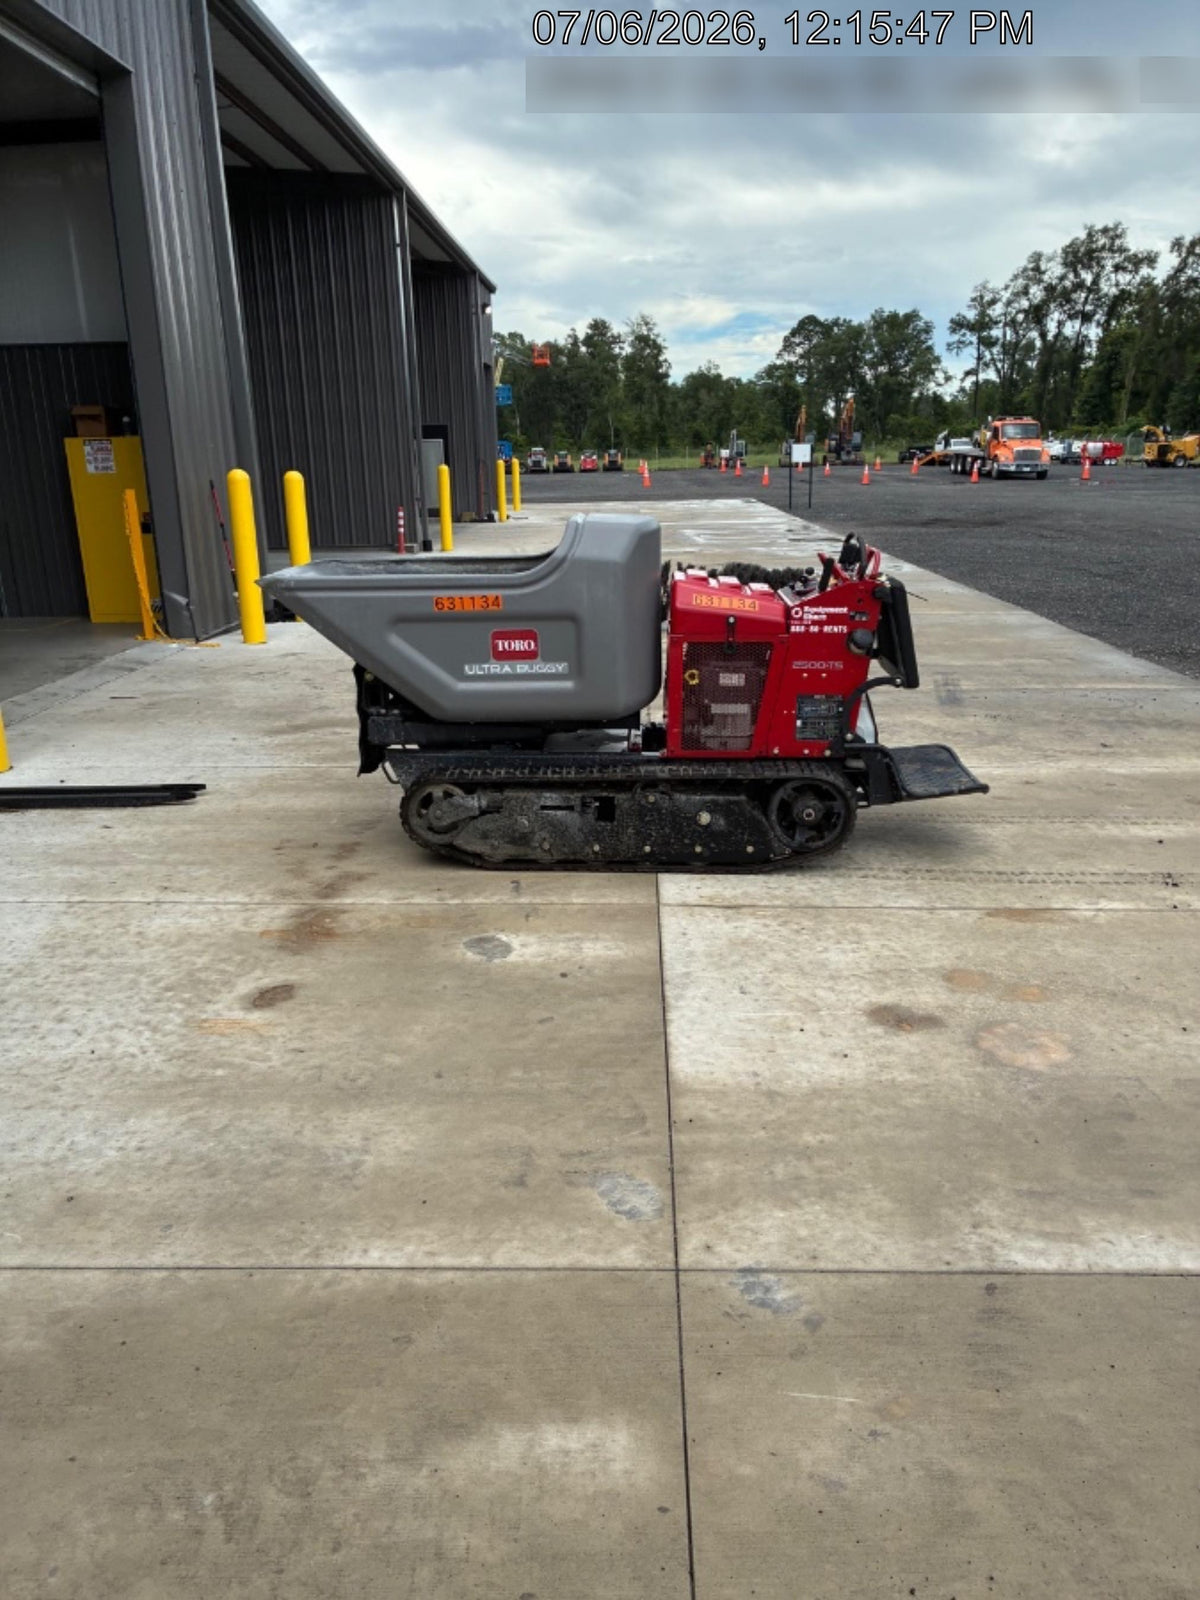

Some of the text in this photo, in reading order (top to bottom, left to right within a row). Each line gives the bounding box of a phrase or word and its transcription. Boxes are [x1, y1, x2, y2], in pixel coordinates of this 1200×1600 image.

[434, 595, 501, 611] 631134
[694, 595, 757, 611] 631134
[495, 639, 535, 651] TORO
[464, 662, 567, 675] ULTRA BUGGY
